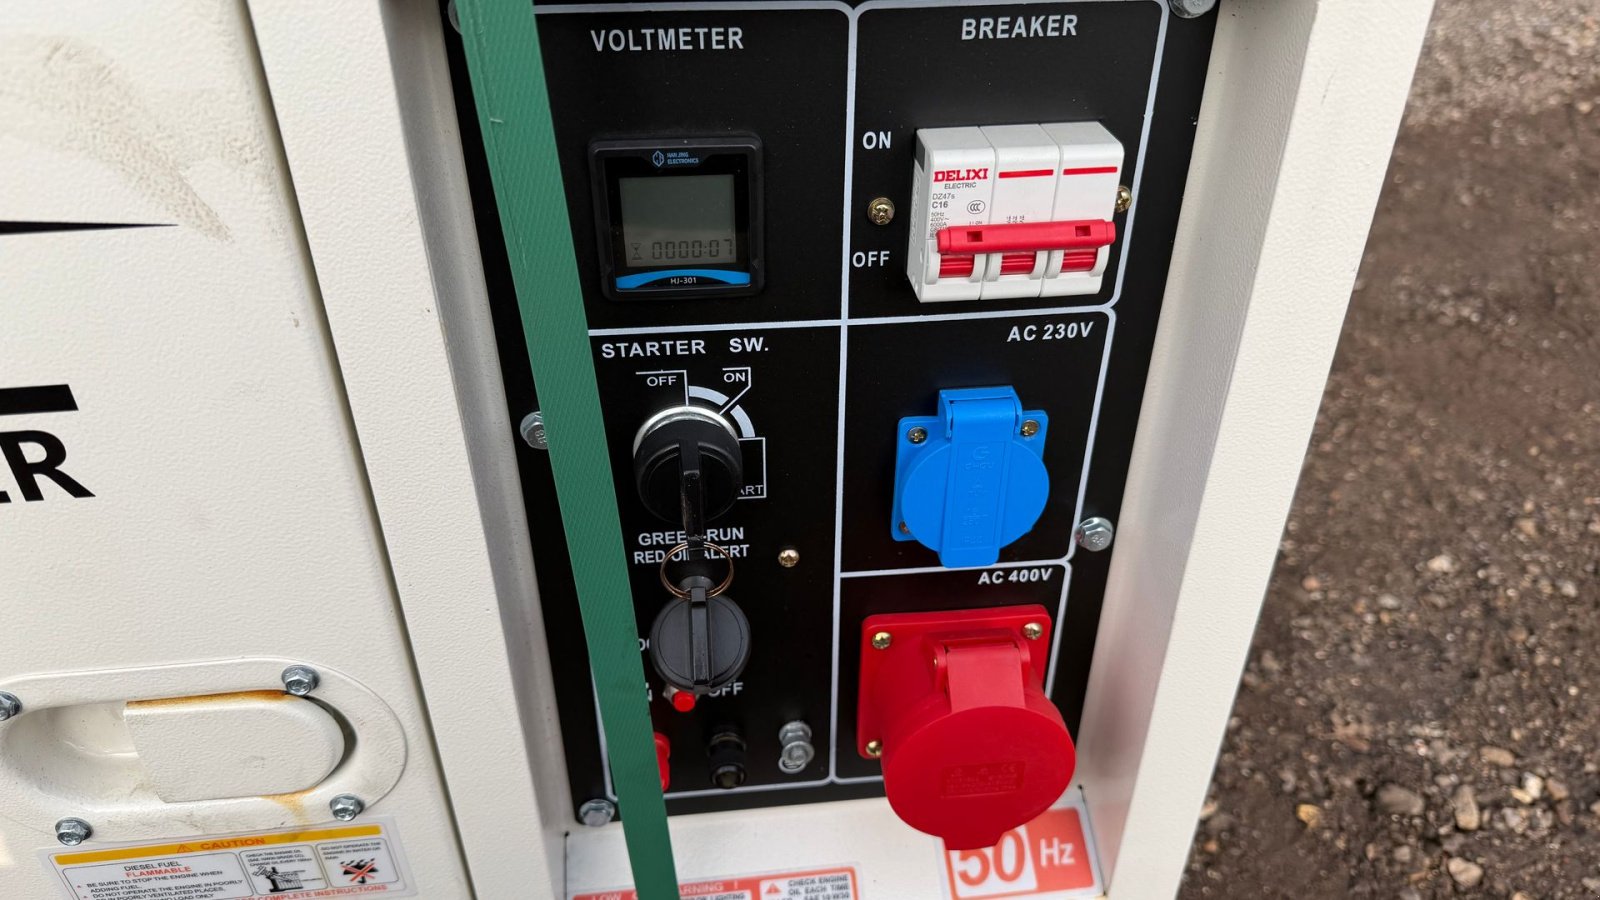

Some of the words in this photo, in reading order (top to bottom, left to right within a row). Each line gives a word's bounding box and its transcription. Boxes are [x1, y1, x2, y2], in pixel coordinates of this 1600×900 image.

[961, 14, 1078, 40] BREAKER
[591, 27, 744, 51] VOLTMETER
[862, 131, 891, 149] ON
[933, 168, 988, 182] DELIXI
[944, 181, 977, 189] ELECTRIC
[931, 201, 949, 209] C16
[852, 251, 890, 268] OFF
[670, 277, 697, 285] HJ-301
[1007, 325, 1037, 342] AC
[1042, 321, 1094, 340] 230V
[602, 339, 706, 358] STARTER
[729, 337, 769, 353] SW.
[646, 376, 677, 386] OFF
[723, 372, 746, 383] ON
[0, 430, 96, 503] R
[633, 550, 666, 565] RED
[978, 570, 1003, 585] AC
[1008, 568, 1053, 583] 400V
[200, 838, 265, 851] CAUTION
[958, 829, 1026, 887] 50
[1040, 837, 1075, 868] Hz
[124, 863, 158, 871] DIESEL
[125, 866, 192, 878] FLAMMABLE
[148, 889, 194, 898] VENTILATED
[315, 884, 388, 897] INSTRUCTIONS
[679, 881, 724, 896] ARNING
